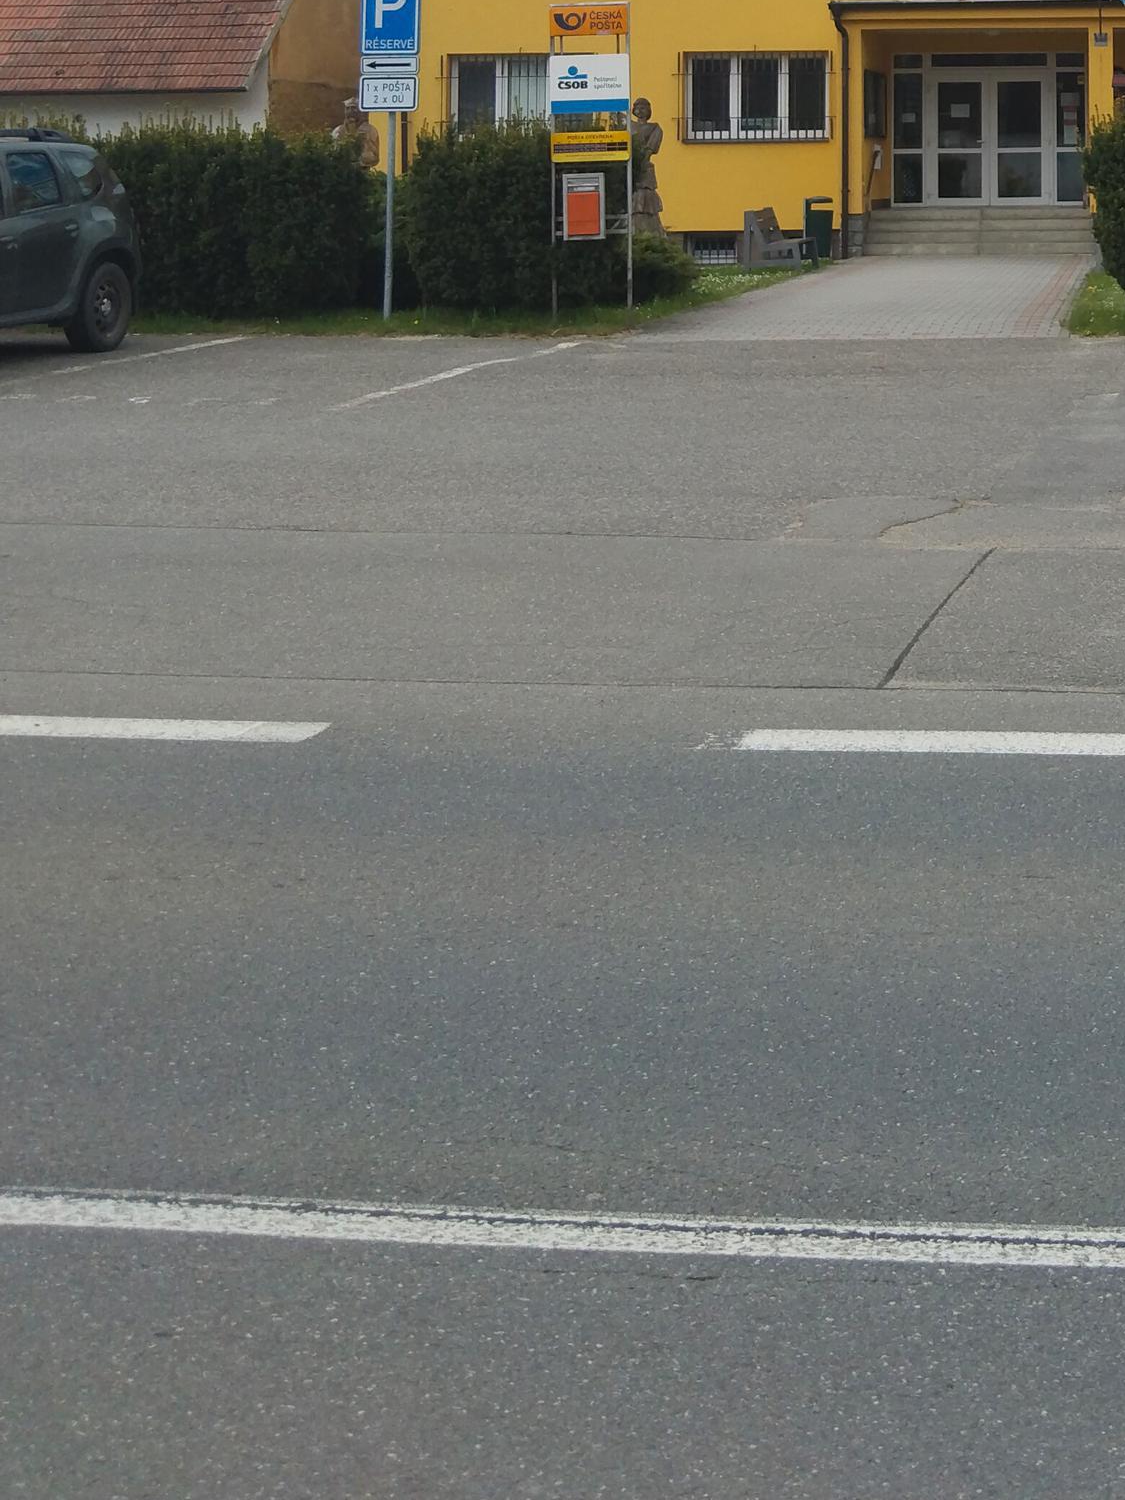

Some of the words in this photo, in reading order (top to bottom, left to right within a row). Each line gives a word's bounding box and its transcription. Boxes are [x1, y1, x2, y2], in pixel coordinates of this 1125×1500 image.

[589, 10, 623, 20] ČESKÁ
[590, 20, 623, 30] POŠTA
[365, 36, 415, 50] RÉSERVÉ
[382, 81, 412, 92] POŠTA
